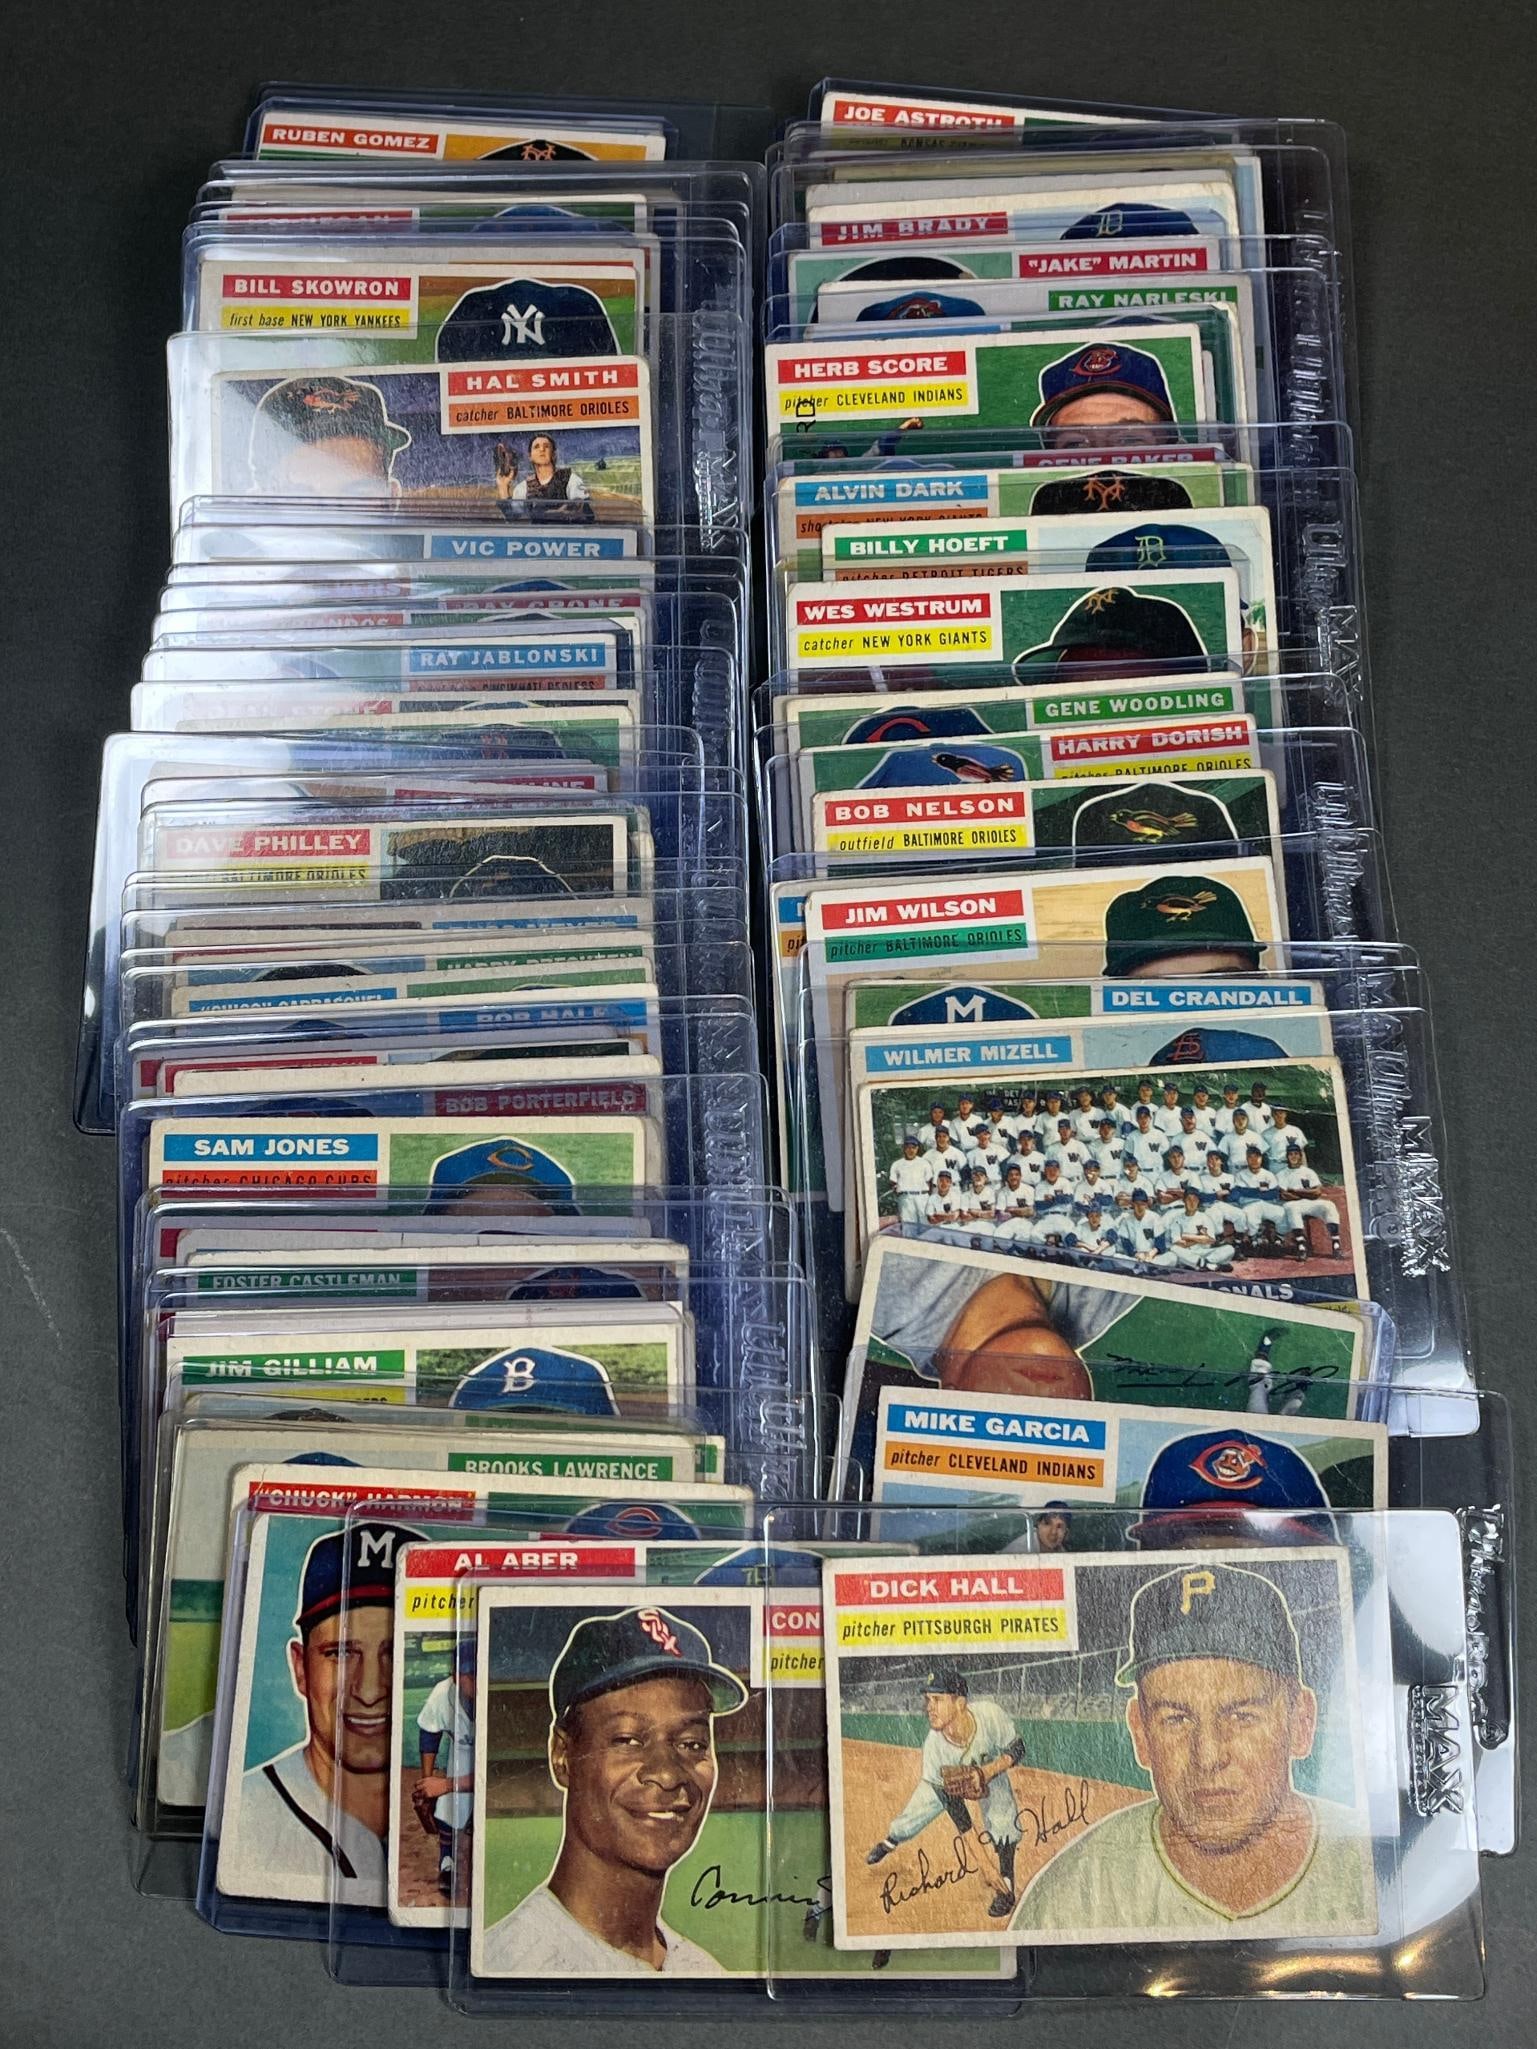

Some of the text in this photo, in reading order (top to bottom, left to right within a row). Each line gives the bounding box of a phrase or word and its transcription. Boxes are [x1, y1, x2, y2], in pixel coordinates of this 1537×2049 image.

[843, 105, 886, 122] JOE
[272, 128, 430, 149] RUBEN GOMEZ
[837, 216, 991, 241] JIM BRADY
[1109, 253, 1197, 270] MARTIN
[234, 279, 399, 296] BILL SKOWRON
[1058, 291, 1229, 309] RAY NARLESKI
[230, 313, 401, 328] first base NEW YORK YANKEES
[794, 356, 948, 378] HERB SCORE
[466, 370, 618, 390] HAL SMITH
[784, 387, 963, 411] pitcher CLEVELAND INDIANS
[456, 400, 630, 423] catcher BALTIMORE ORIOLES
[814, 481, 965, 501] ALVIN DARK
[451, 540, 601, 557] VIC POWER
[849, 536, 1009, 556] BILLY HOEFT
[804, 599, 982, 621] WES WESTRUM
[804, 631, 987, 651] catcher NEW YORK GIANTS
[420, 648, 598, 666] RAY JABLONSKI
[1045, 693, 1225, 717] GENE WOODLING
[1058, 725, 1243, 755] HARRY DORISH
[835, 797, 1014, 821] BOB NELSON
[176, 834, 362, 853] DAVE PHILLEY
[839, 828, 1017, 851] outfield BALTIMORE ORIOLES
[845, 897, 997, 924] JIM WILSON
[830, 928, 1022, 958] pitcher BALTIMORE ORIOLES
[945, 994, 986, 1023] M
[1111, 990, 1303, 1007] DEL CRANDALL
[883, 1042, 1059, 1066] WILMER MIZELL
[445, 1090, 636, 1113] BOB PORTERFIELD
[193, 1138, 350, 1155] SAM JONES
[213, 1273, 401, 1289] FOSTER CASTLEMAN
[205, 1356, 377, 1378] JIM GILLIAM
[502, 1357, 536, 1393] B
[904, 1410, 1090, 1443] MIKE GARCIA
[465, 1460, 658, 1480] BROOKS LAWRENCE
[890, 1450, 1096, 1480] pitcher CLEVELAND INDIANS
[357, 1529, 396, 1569] M
[454, 1552, 579, 1571] AL ABER
[869, 1576, 1024, 1599] DICK HALL
[1180, 1570, 1216, 1616] P
[412, 1593, 475, 1612] pitcher
[842, 1616, 1059, 1641] pitcher PITTSBURGH PIRATES
[770, 1653, 824, 1673] pitcher
[880, 1836, 979, 1914] Richard
